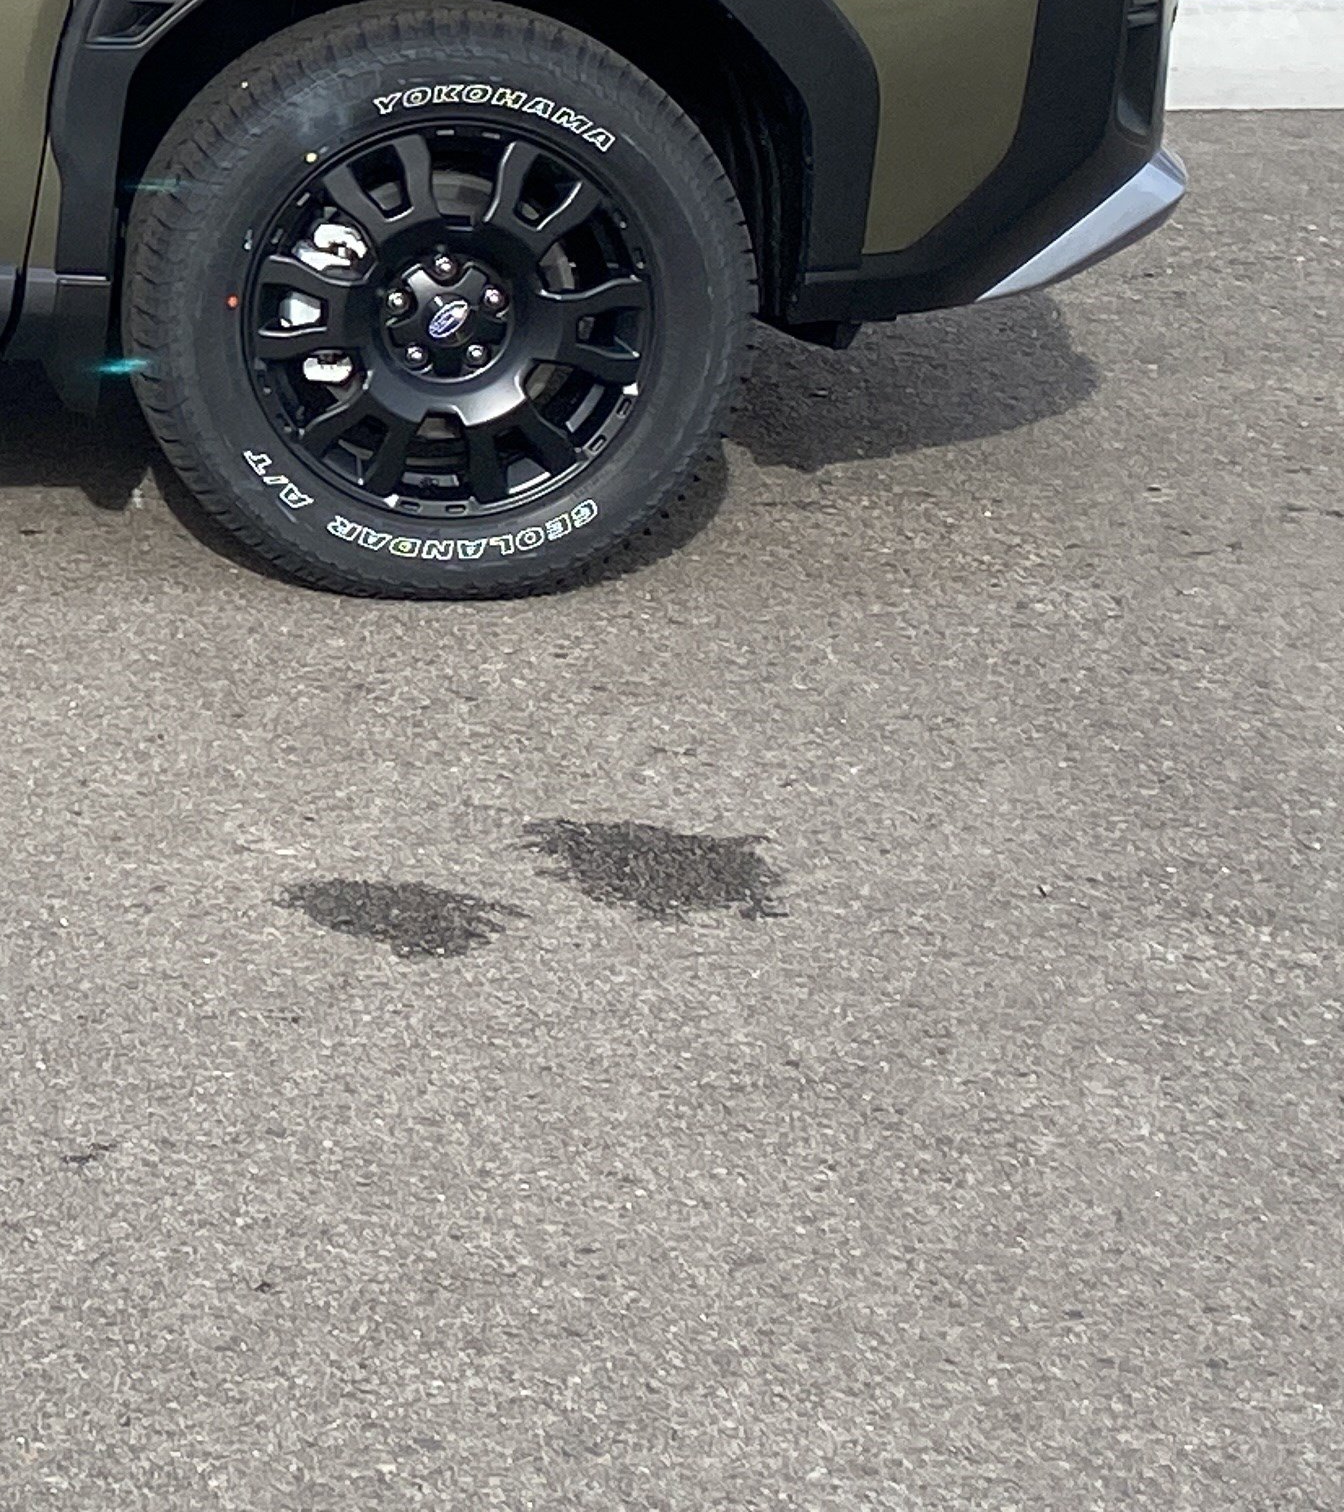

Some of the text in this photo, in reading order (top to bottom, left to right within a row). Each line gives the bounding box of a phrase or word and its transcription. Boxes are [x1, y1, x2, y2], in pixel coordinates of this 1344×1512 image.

[373, 84, 616, 152] YOKOHAMA
[243, 450, 598, 560] GEOLANDAR A/T
